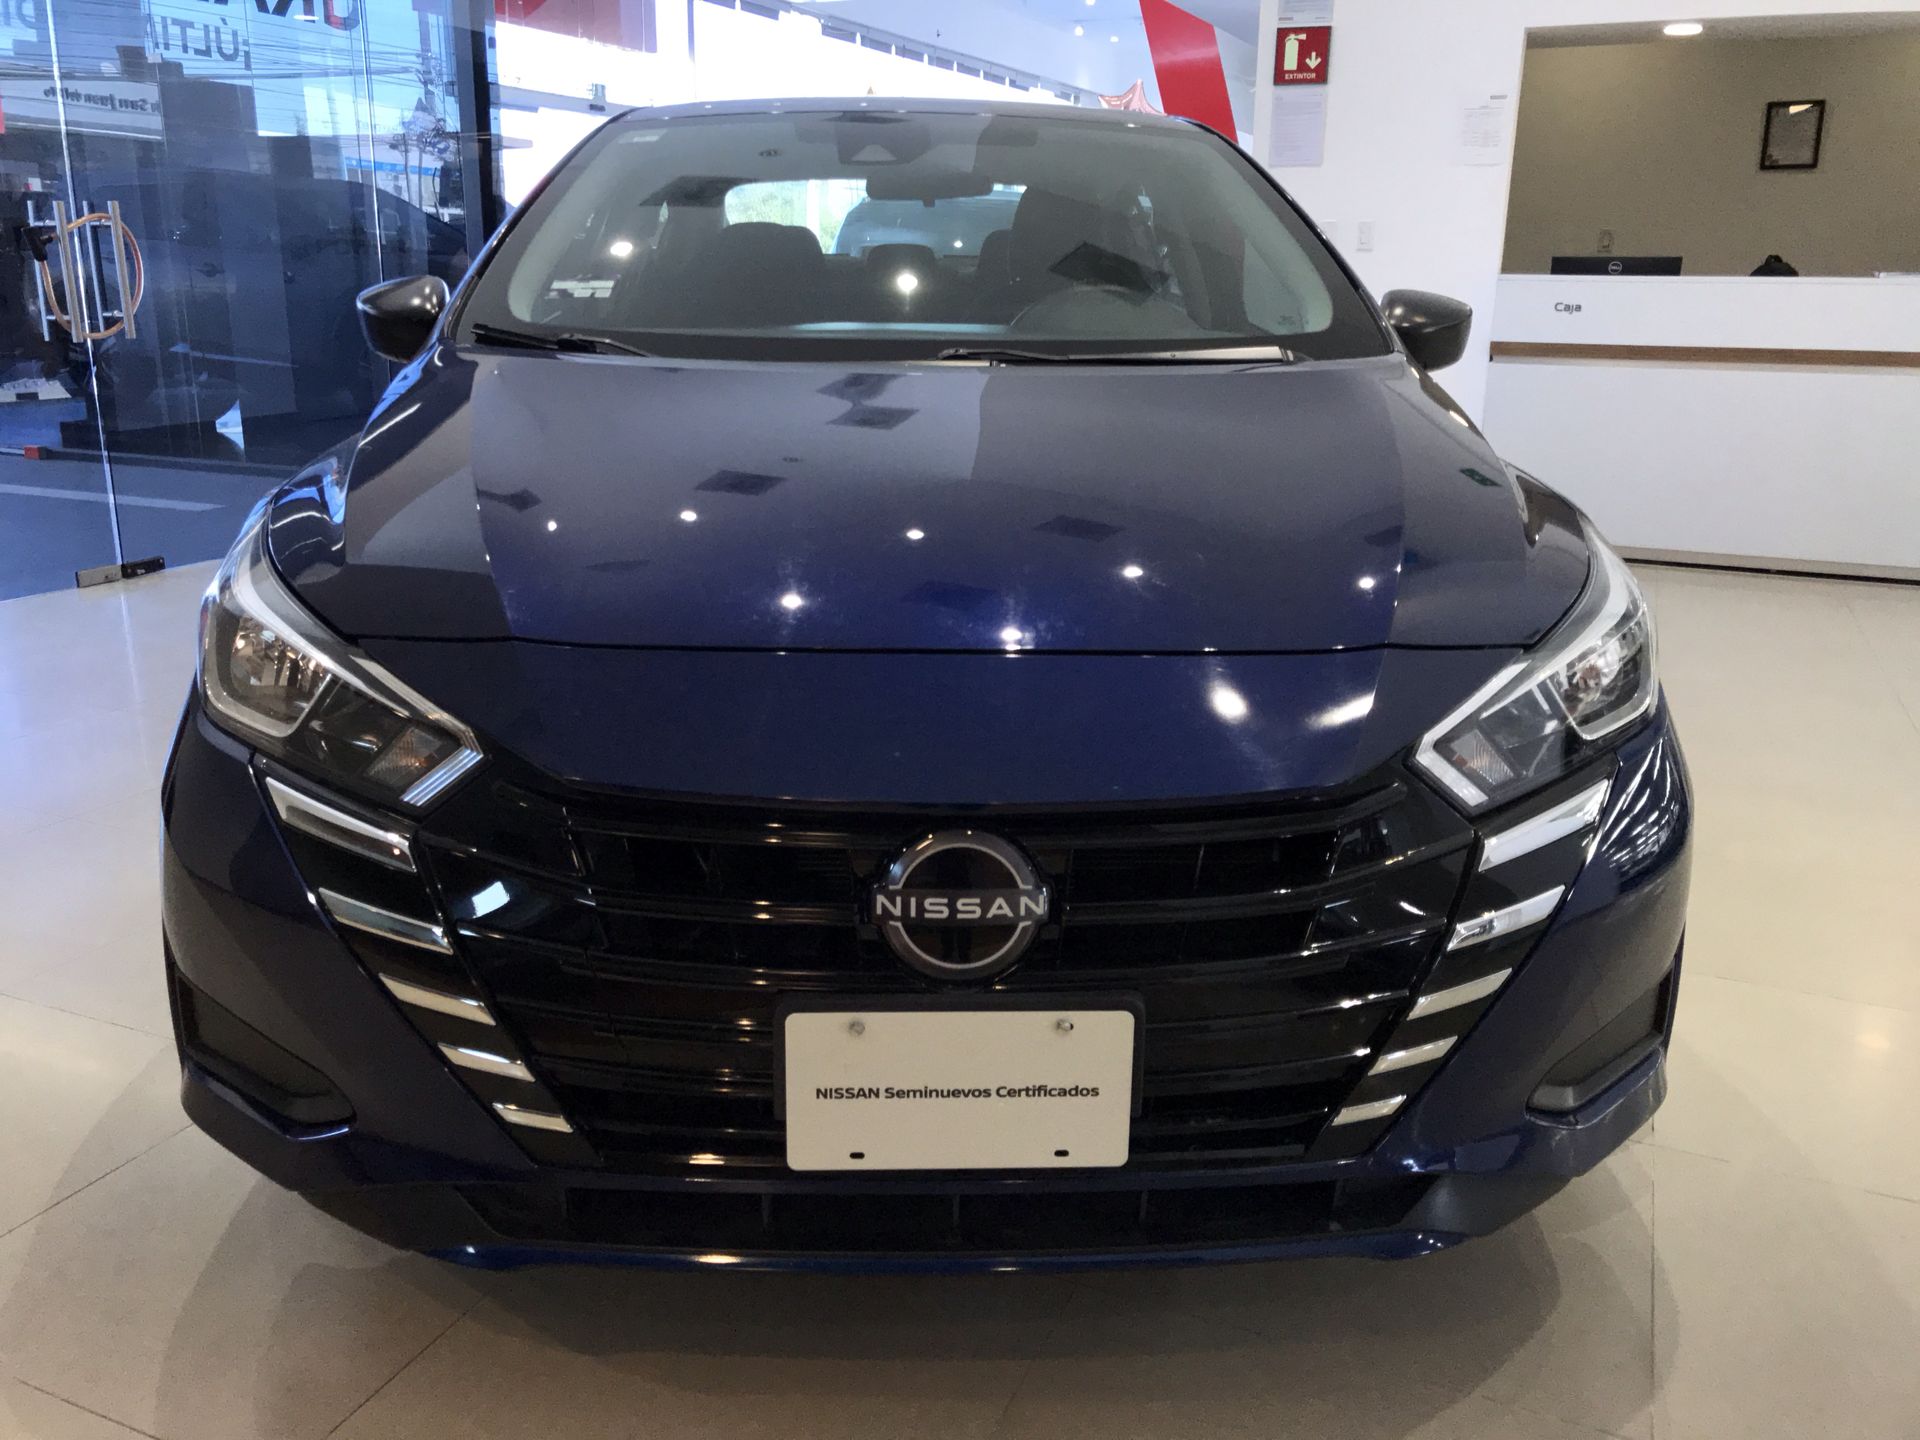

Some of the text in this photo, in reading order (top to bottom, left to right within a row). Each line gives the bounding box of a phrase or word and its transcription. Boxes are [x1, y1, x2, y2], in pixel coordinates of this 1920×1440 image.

[1284, 72, 1316, 80] EXTINTOR
[1554, 302, 1582, 314] Caja
[876, 894, 1045, 919] NISSAN
[815, 1085, 1100, 1099] NISSAN Seminuevos Certificados
